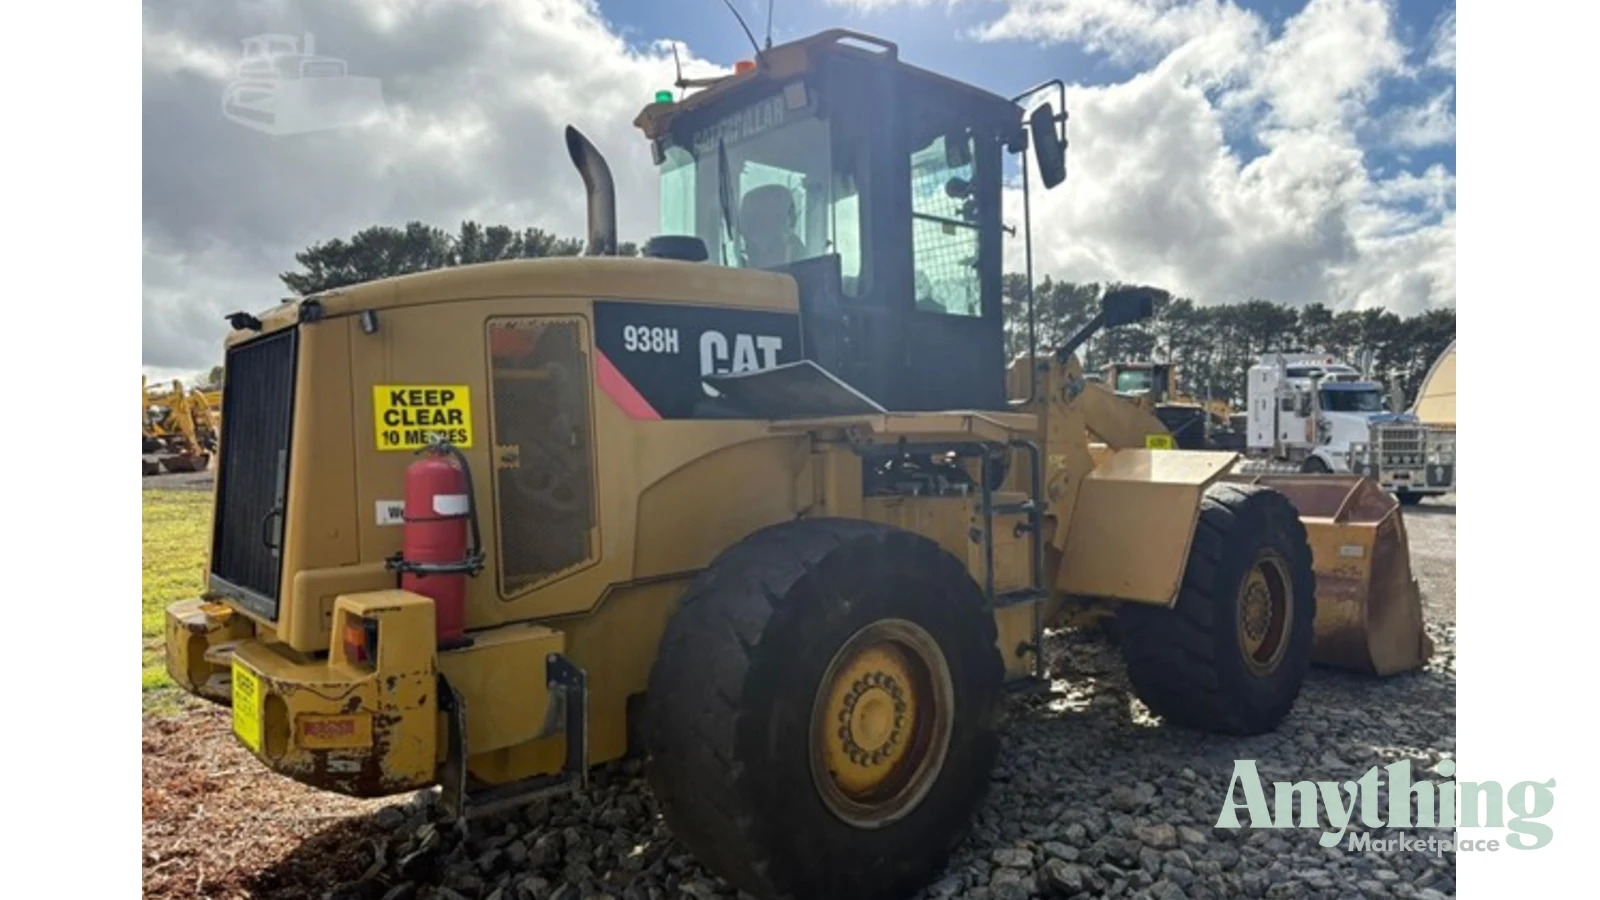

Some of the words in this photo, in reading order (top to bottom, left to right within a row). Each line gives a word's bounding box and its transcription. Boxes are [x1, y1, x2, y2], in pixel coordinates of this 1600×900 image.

[624, 325, 679, 353] 938H
[700, 330, 782, 397] CAT
[390, 389, 455, 406] KEEP
[383, 409, 463, 426] CLEAR
[382, 430, 400, 445] 10
[405, 429, 468, 444] MERES
